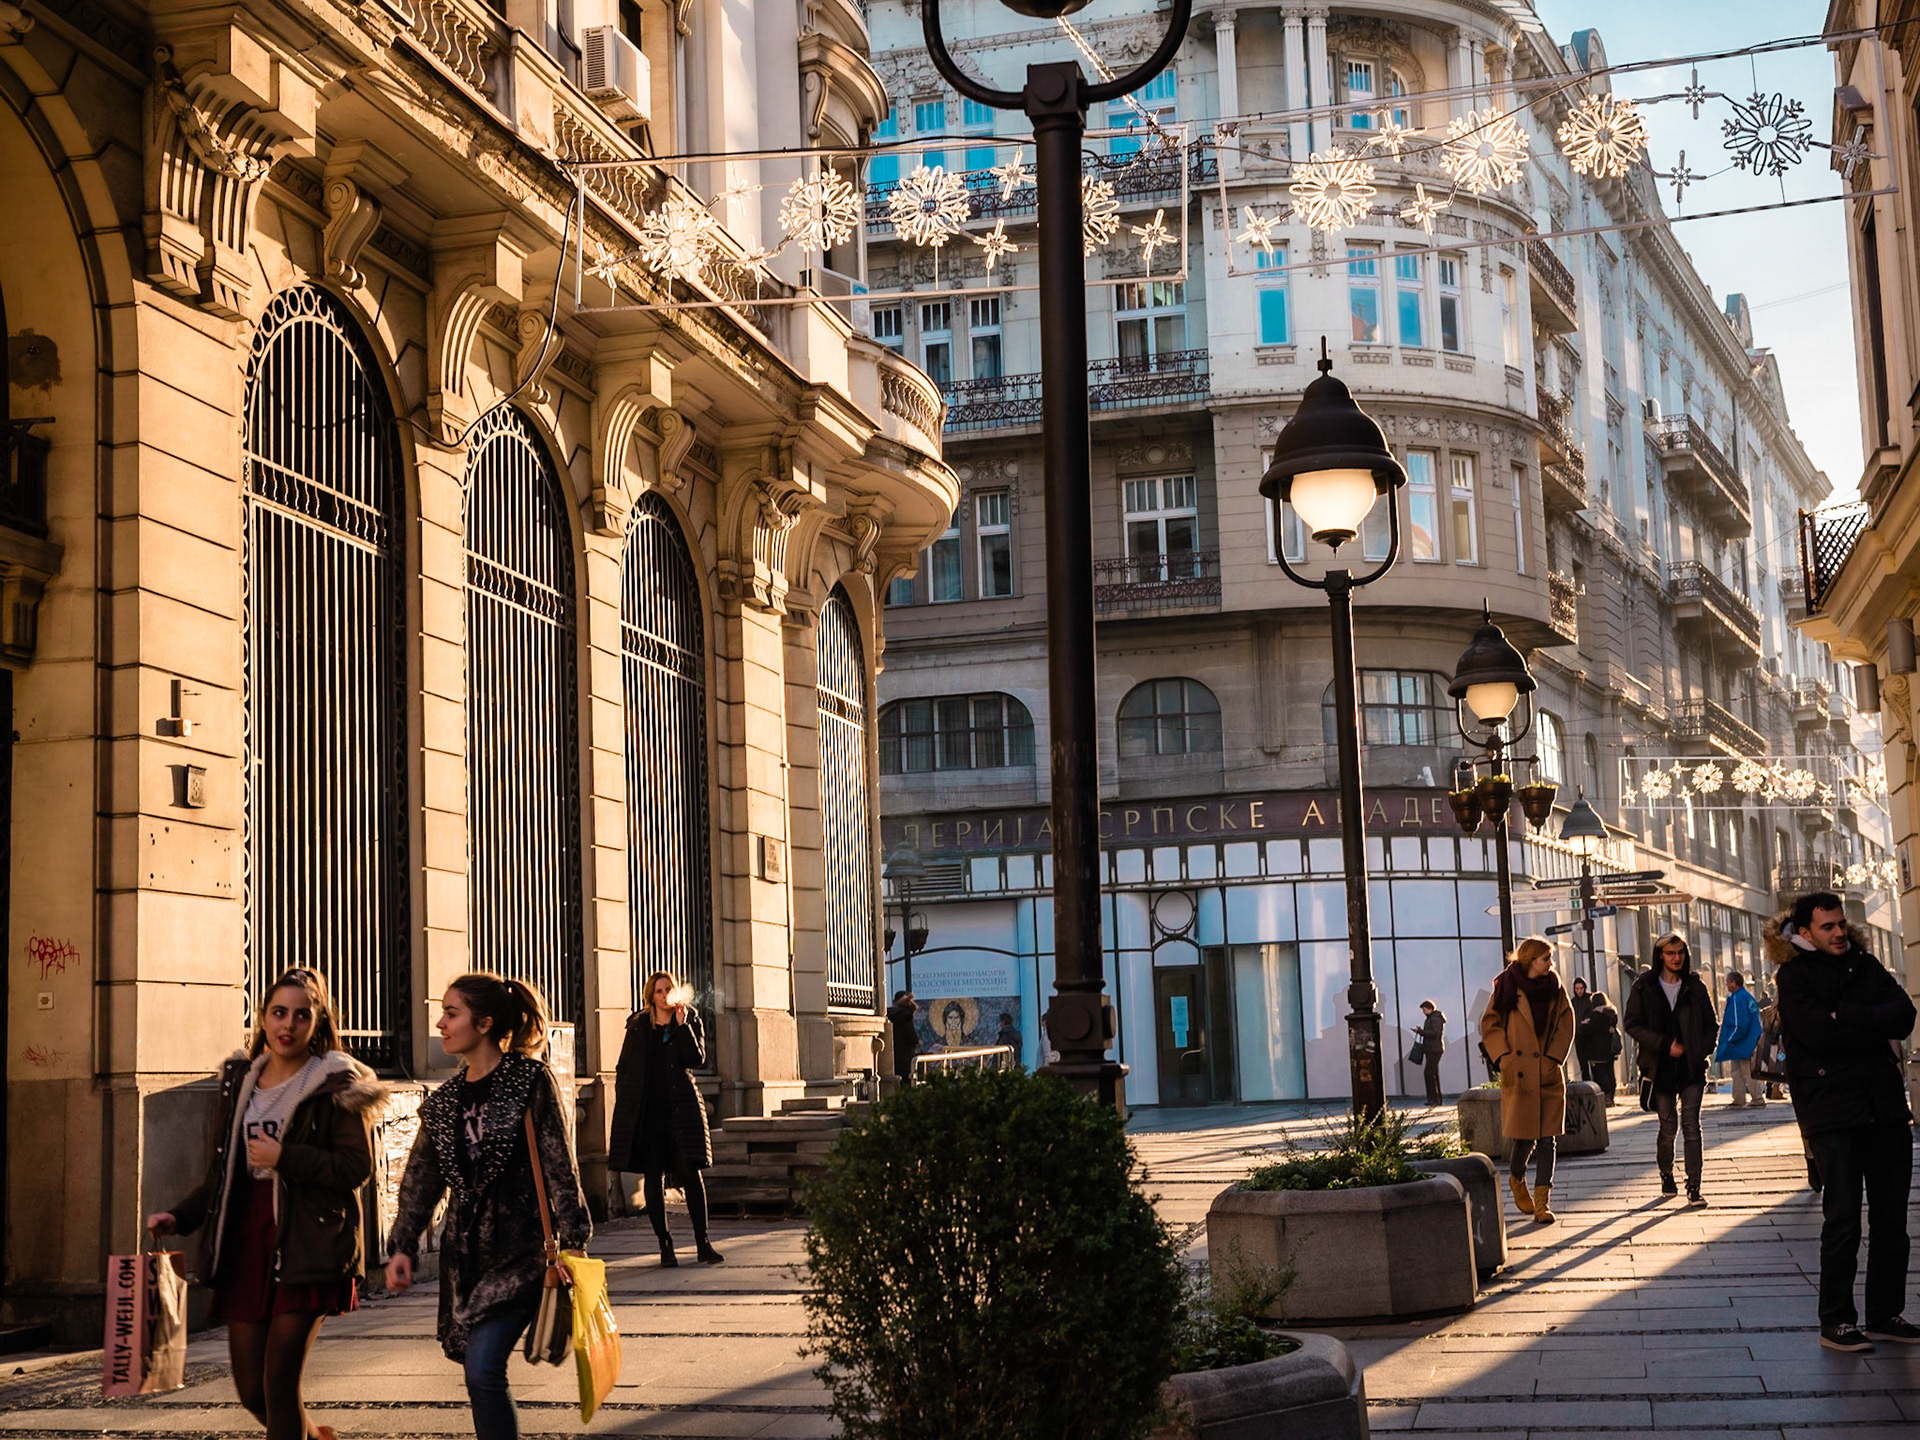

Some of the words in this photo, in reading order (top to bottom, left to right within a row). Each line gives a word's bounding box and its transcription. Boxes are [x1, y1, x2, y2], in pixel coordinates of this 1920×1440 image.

[881, 817, 1053, 851] ЛЕРИЈА
[1099, 801, 1264, 840] СРПСКЕ
[1302, 797, 1456, 829] ААДЕ
